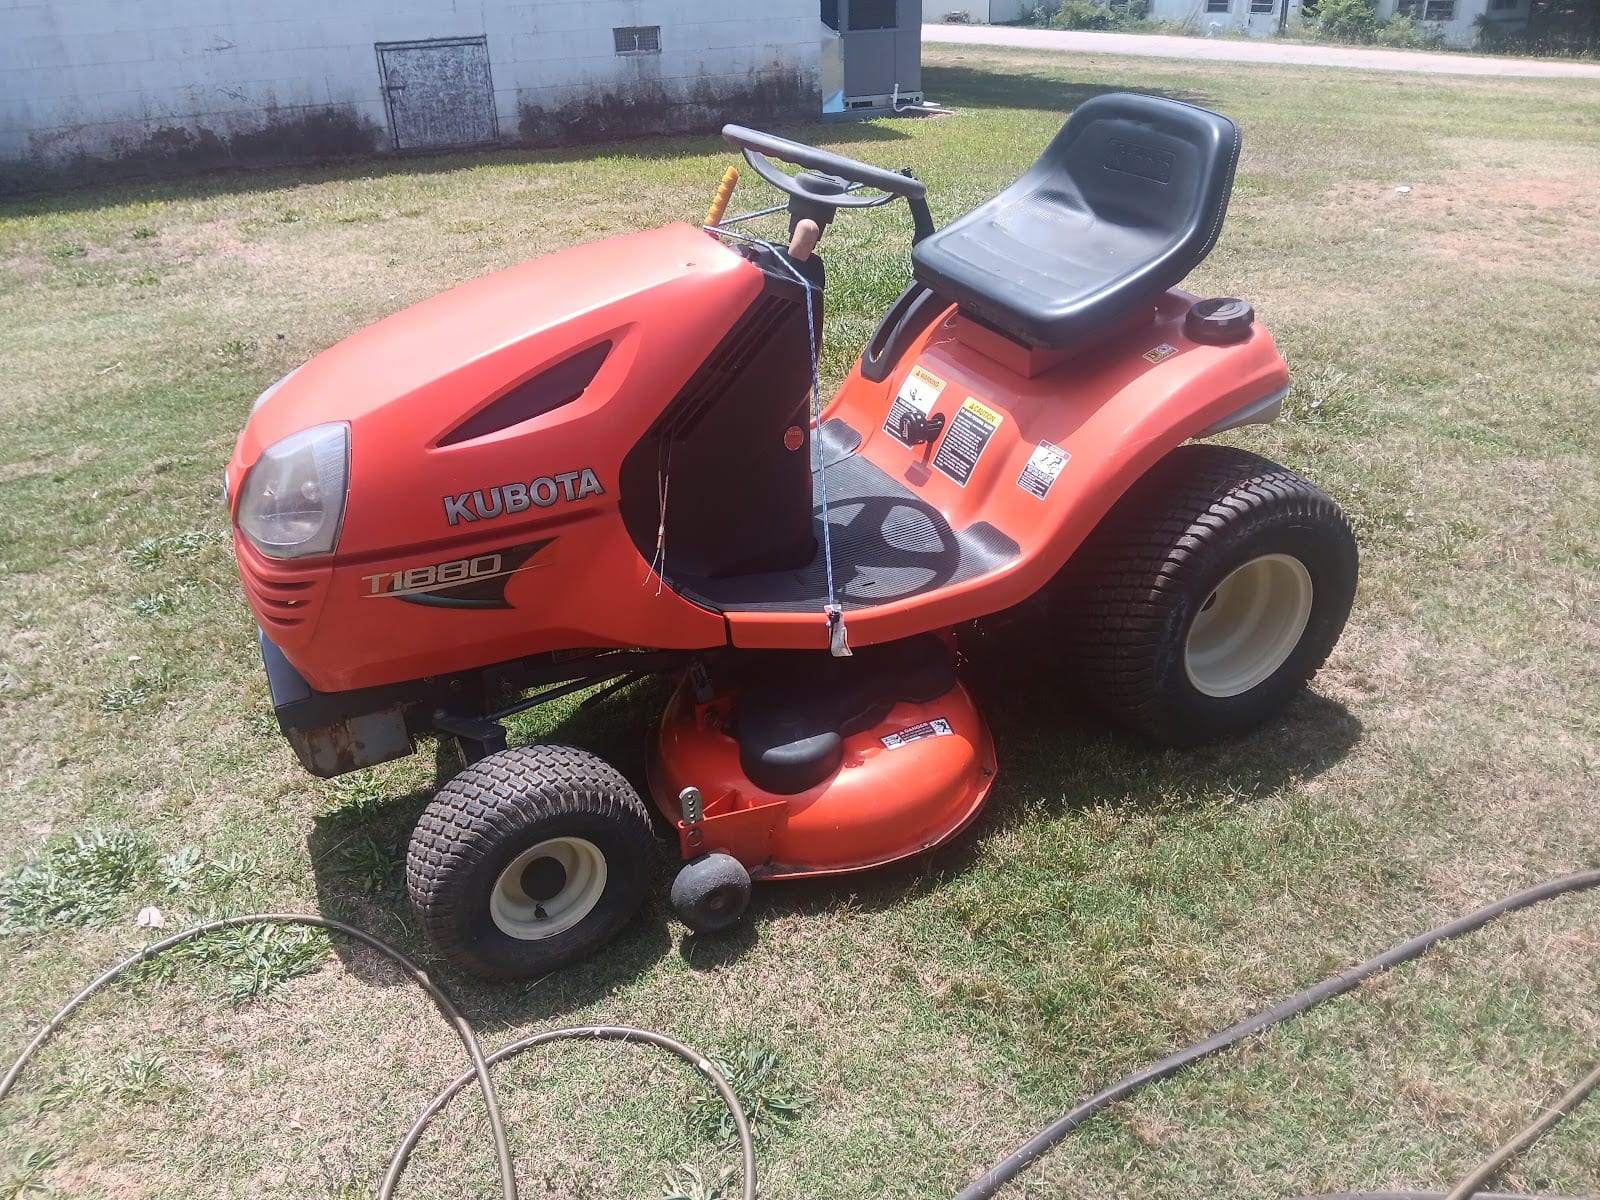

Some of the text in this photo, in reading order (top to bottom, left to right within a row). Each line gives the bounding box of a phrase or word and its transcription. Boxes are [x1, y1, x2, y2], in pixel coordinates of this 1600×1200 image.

[973, 405, 996, 422] CAUTION
[443, 468, 605, 525] KUBOTA
[361, 553, 502, 593] T1880
[903, 723, 929, 733] DANGER
